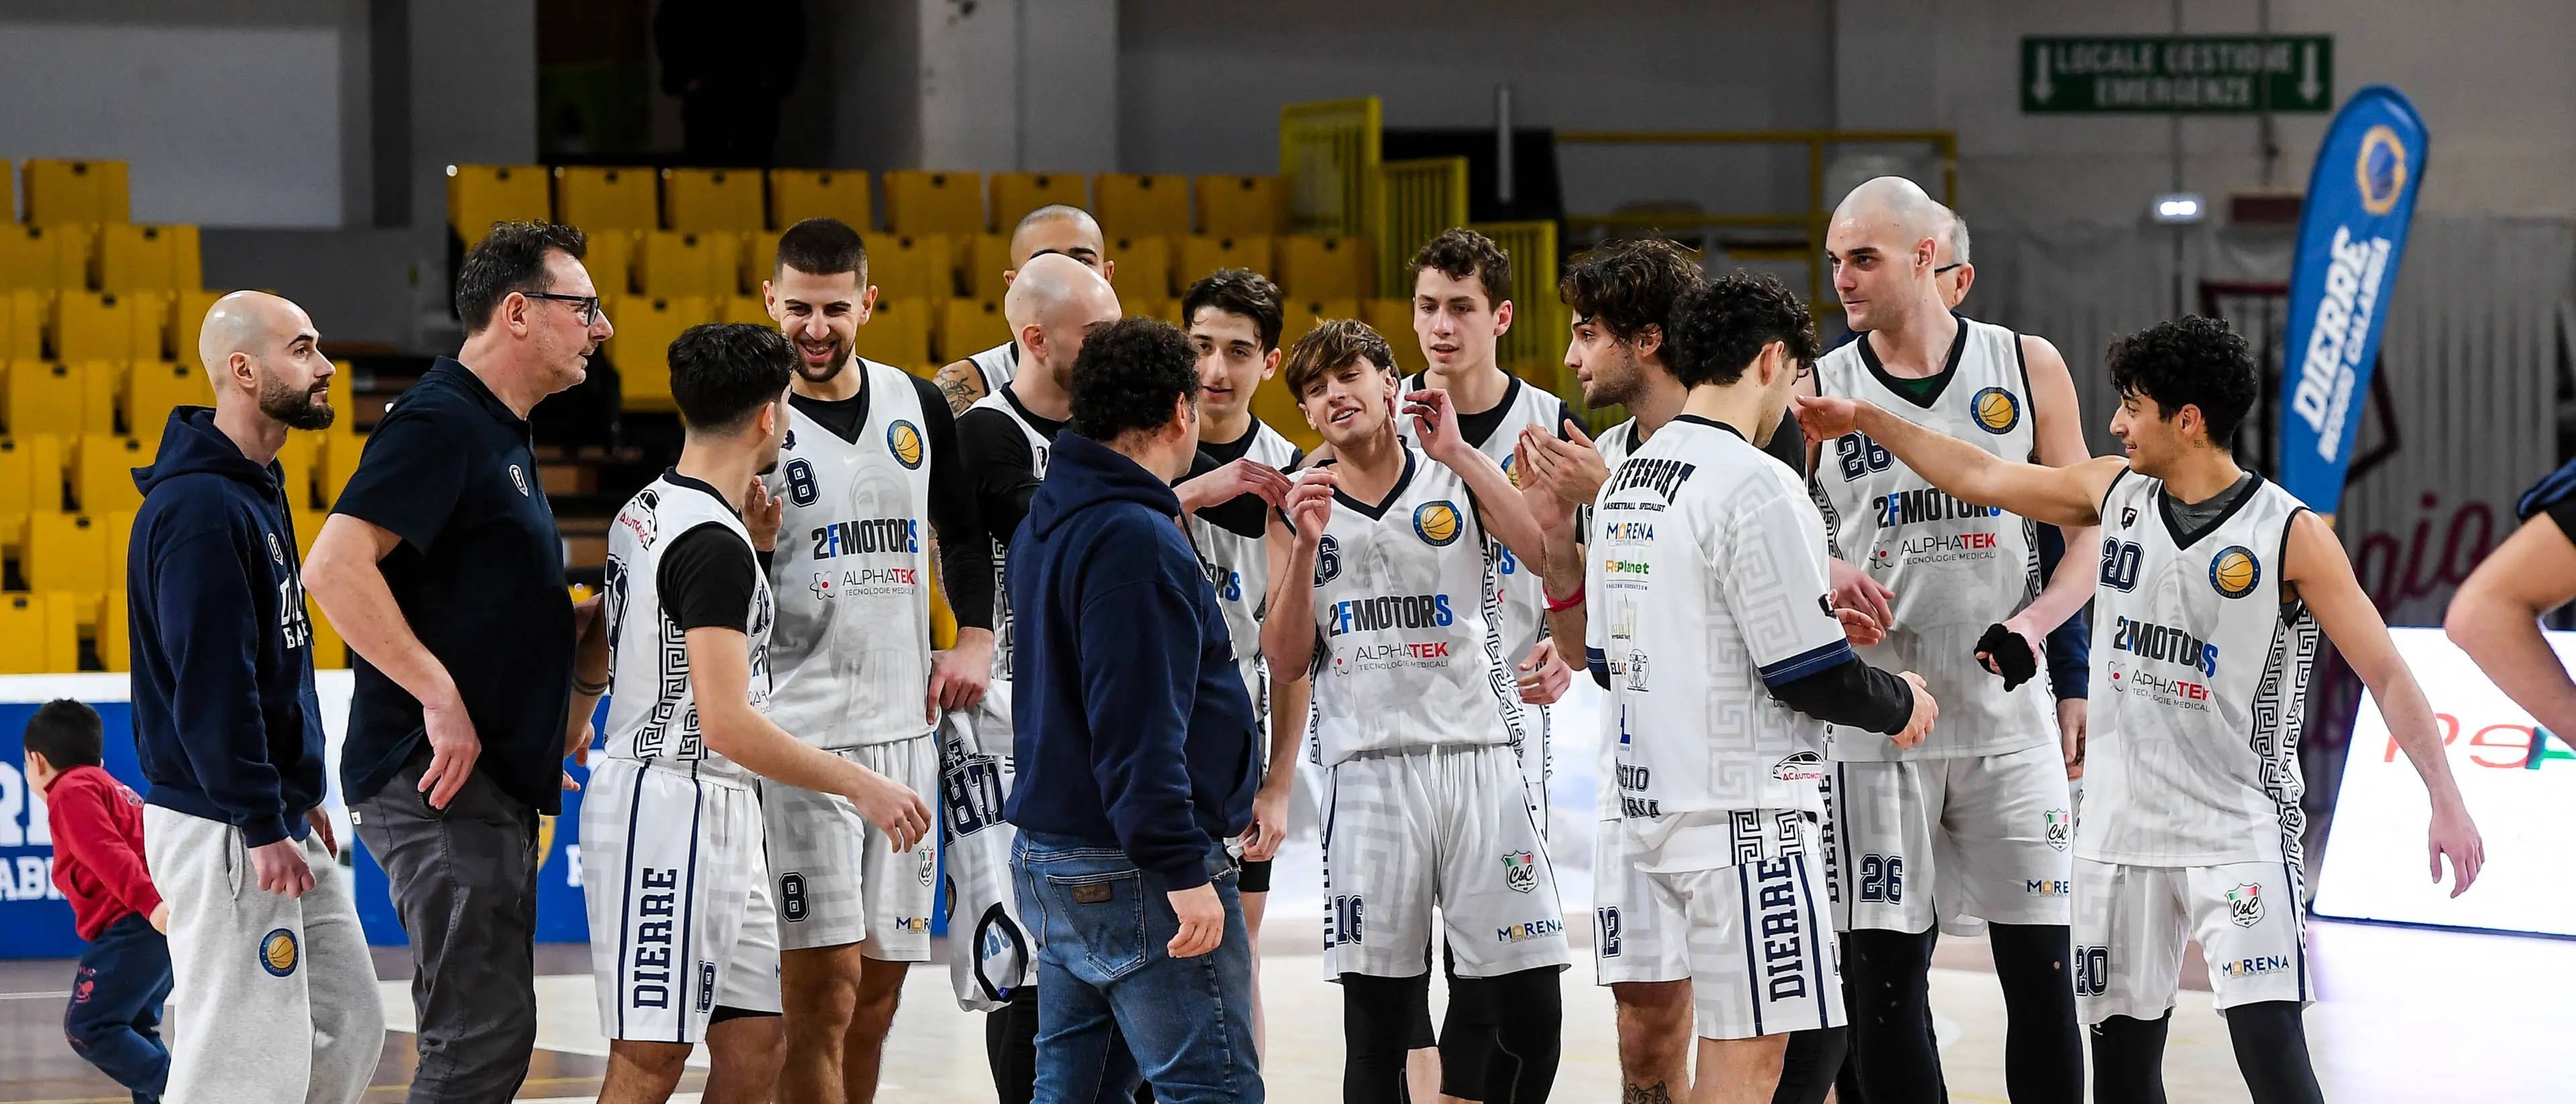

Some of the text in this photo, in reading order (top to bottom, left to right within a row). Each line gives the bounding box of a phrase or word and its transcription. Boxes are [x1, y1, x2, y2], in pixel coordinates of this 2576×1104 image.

[2294, 225, 2371, 434] DIERRE
[1835, 430, 1894, 483] 26
[783, 457, 820, 507] 8
[811, 519, 918, 560] 2FMOTORS
[1606, 522, 1654, 541] MORENA
[1900, 533, 1997, 556] ALPHATEK
[843, 568, 916, 587] ALPHATEK
[1903, 554, 1956, 566] TECNOLOGIE
[2100, 537, 2145, 593] 20
[845, 587, 890, 596] TECNOLOGIE
[1328, 594, 1454, 638] 2FMOTORS
[1355, 641, 1449, 662] ALPHATEK
[1509, 864, 1535, 884] C&C
[1860, 853, 1903, 905] 26
[778, 872, 810, 923] 8
[2233, 896, 2259, 918] C&C
[633, 868, 677, 1009] DIERRE
[1335, 895, 1364, 945] 16
[1497, 919, 1564, 942] MORENA
[1598, 906, 1622, 958] 12
[1756, 856, 1807, 1003] DIERRE
[2075, 946, 2108, 997] 20
[2222, 954, 2290, 977] MORENA
